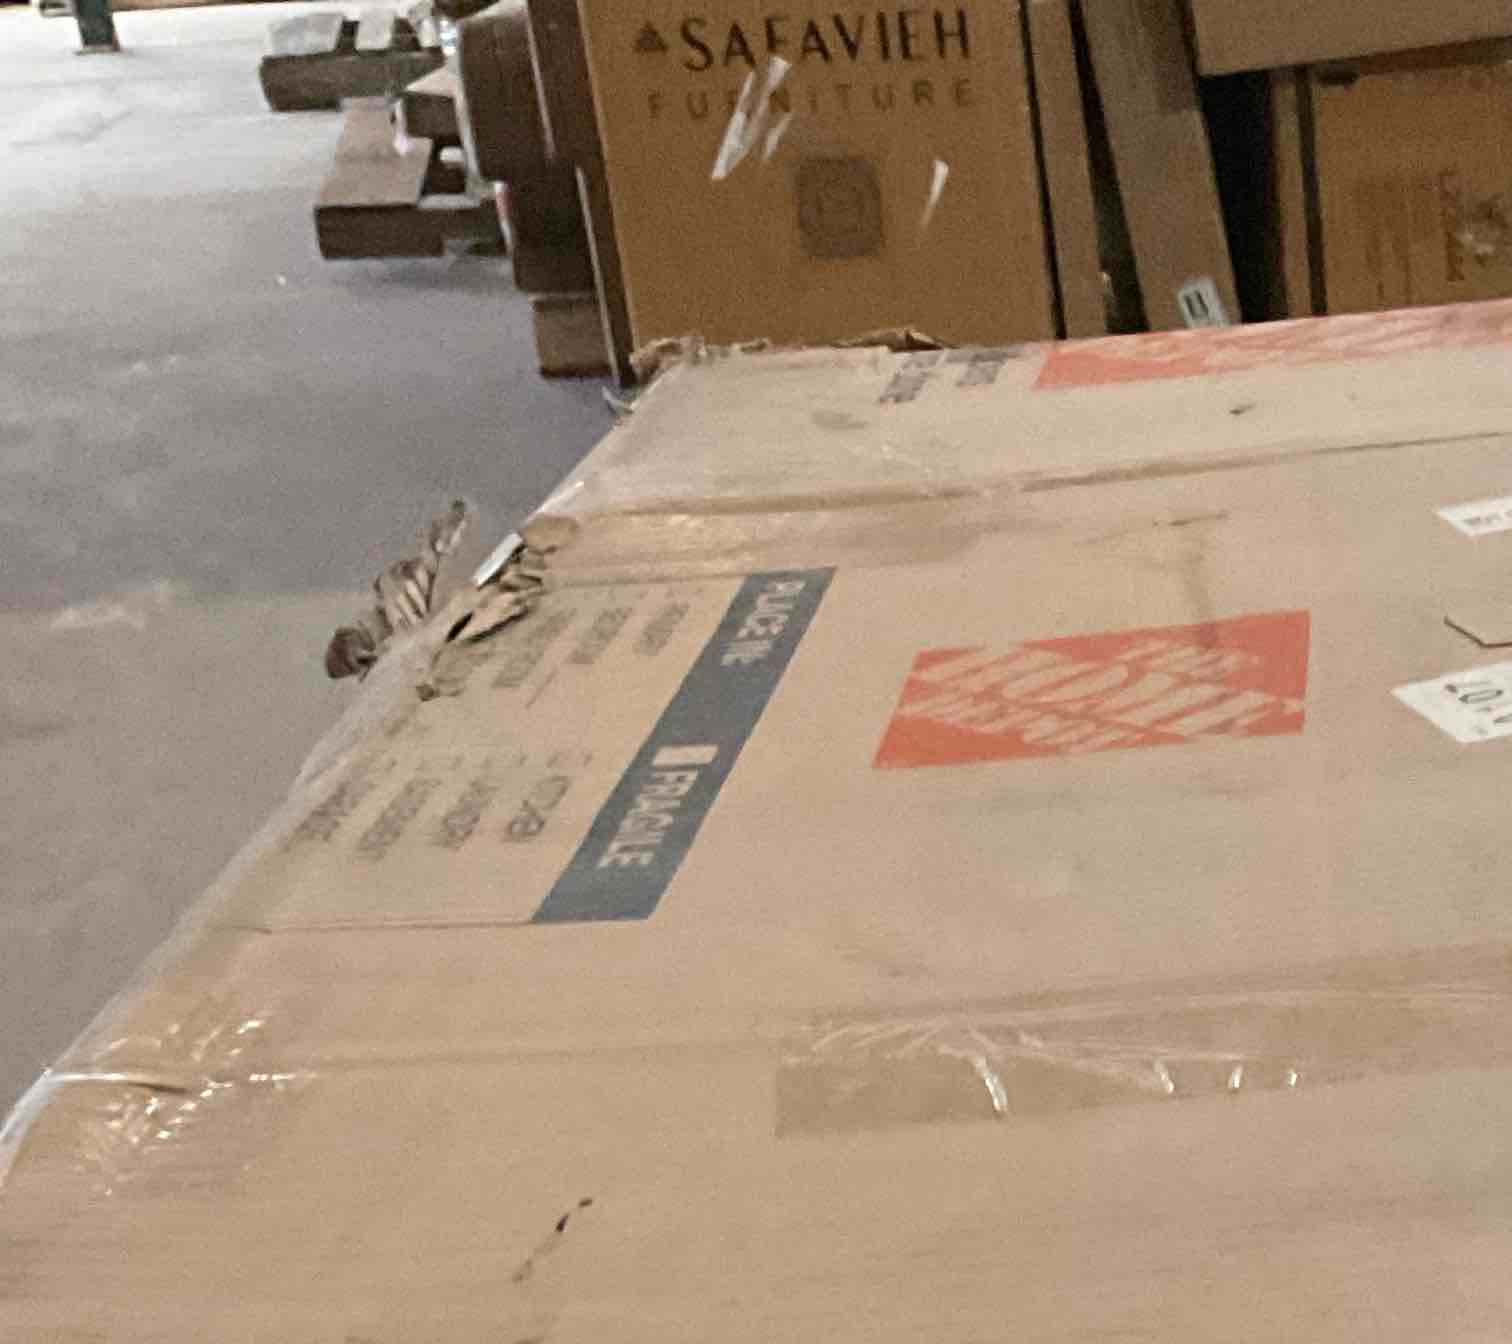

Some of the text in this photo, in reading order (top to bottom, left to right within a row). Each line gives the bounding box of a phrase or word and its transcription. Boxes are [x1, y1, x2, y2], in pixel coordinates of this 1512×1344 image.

[680, 10, 972, 72] SAFAVIEH
[647, 78, 976, 120] FURNITURE
[597, 769, 699, 868] FRAGILE
